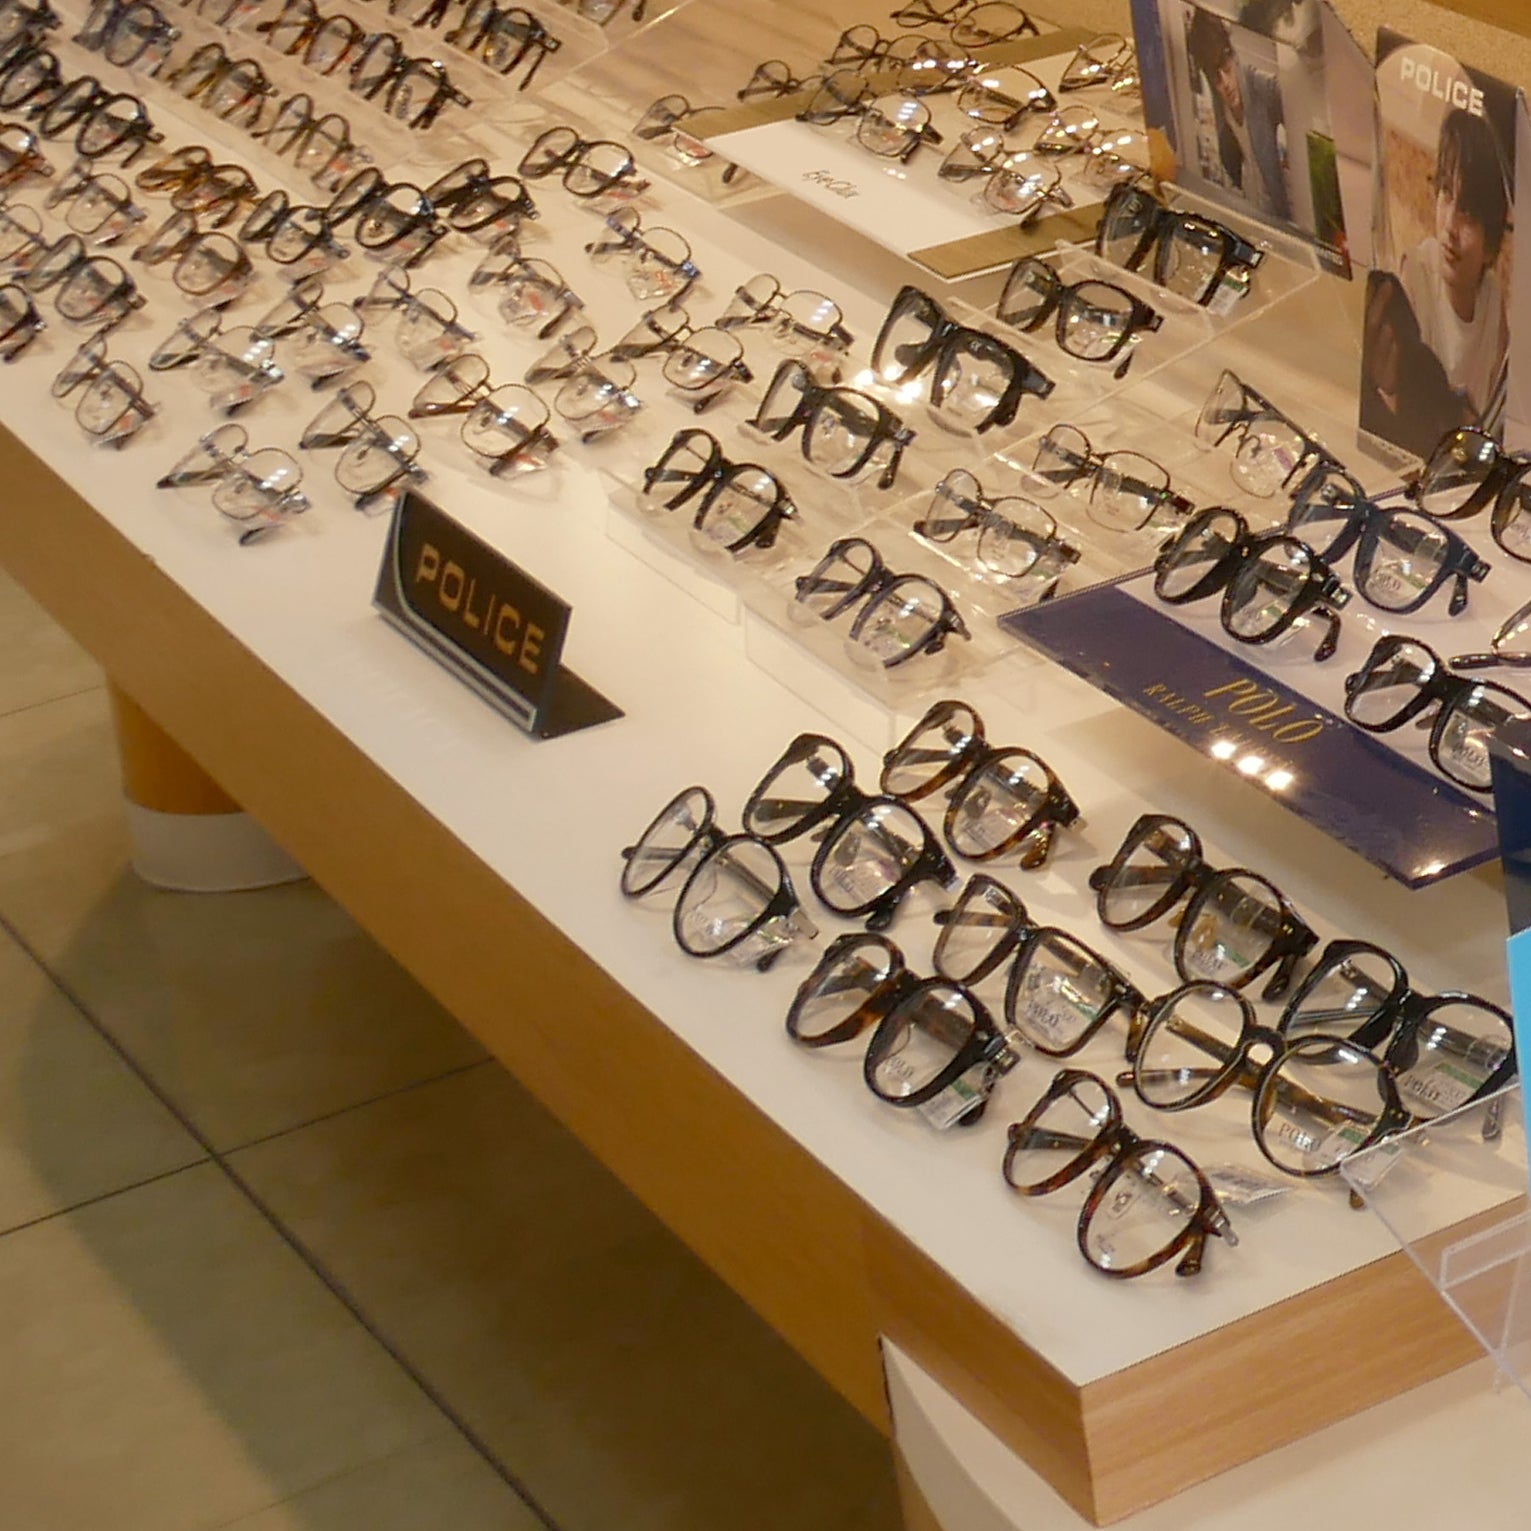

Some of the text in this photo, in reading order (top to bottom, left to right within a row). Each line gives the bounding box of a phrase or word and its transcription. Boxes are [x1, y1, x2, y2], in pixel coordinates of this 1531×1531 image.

[1400, 57, 1485, 117] POLICE
[416, 543, 546, 675] POLICE
[1142, 684, 1215, 725] RALPH
[1204, 679, 1325, 744] POLO
